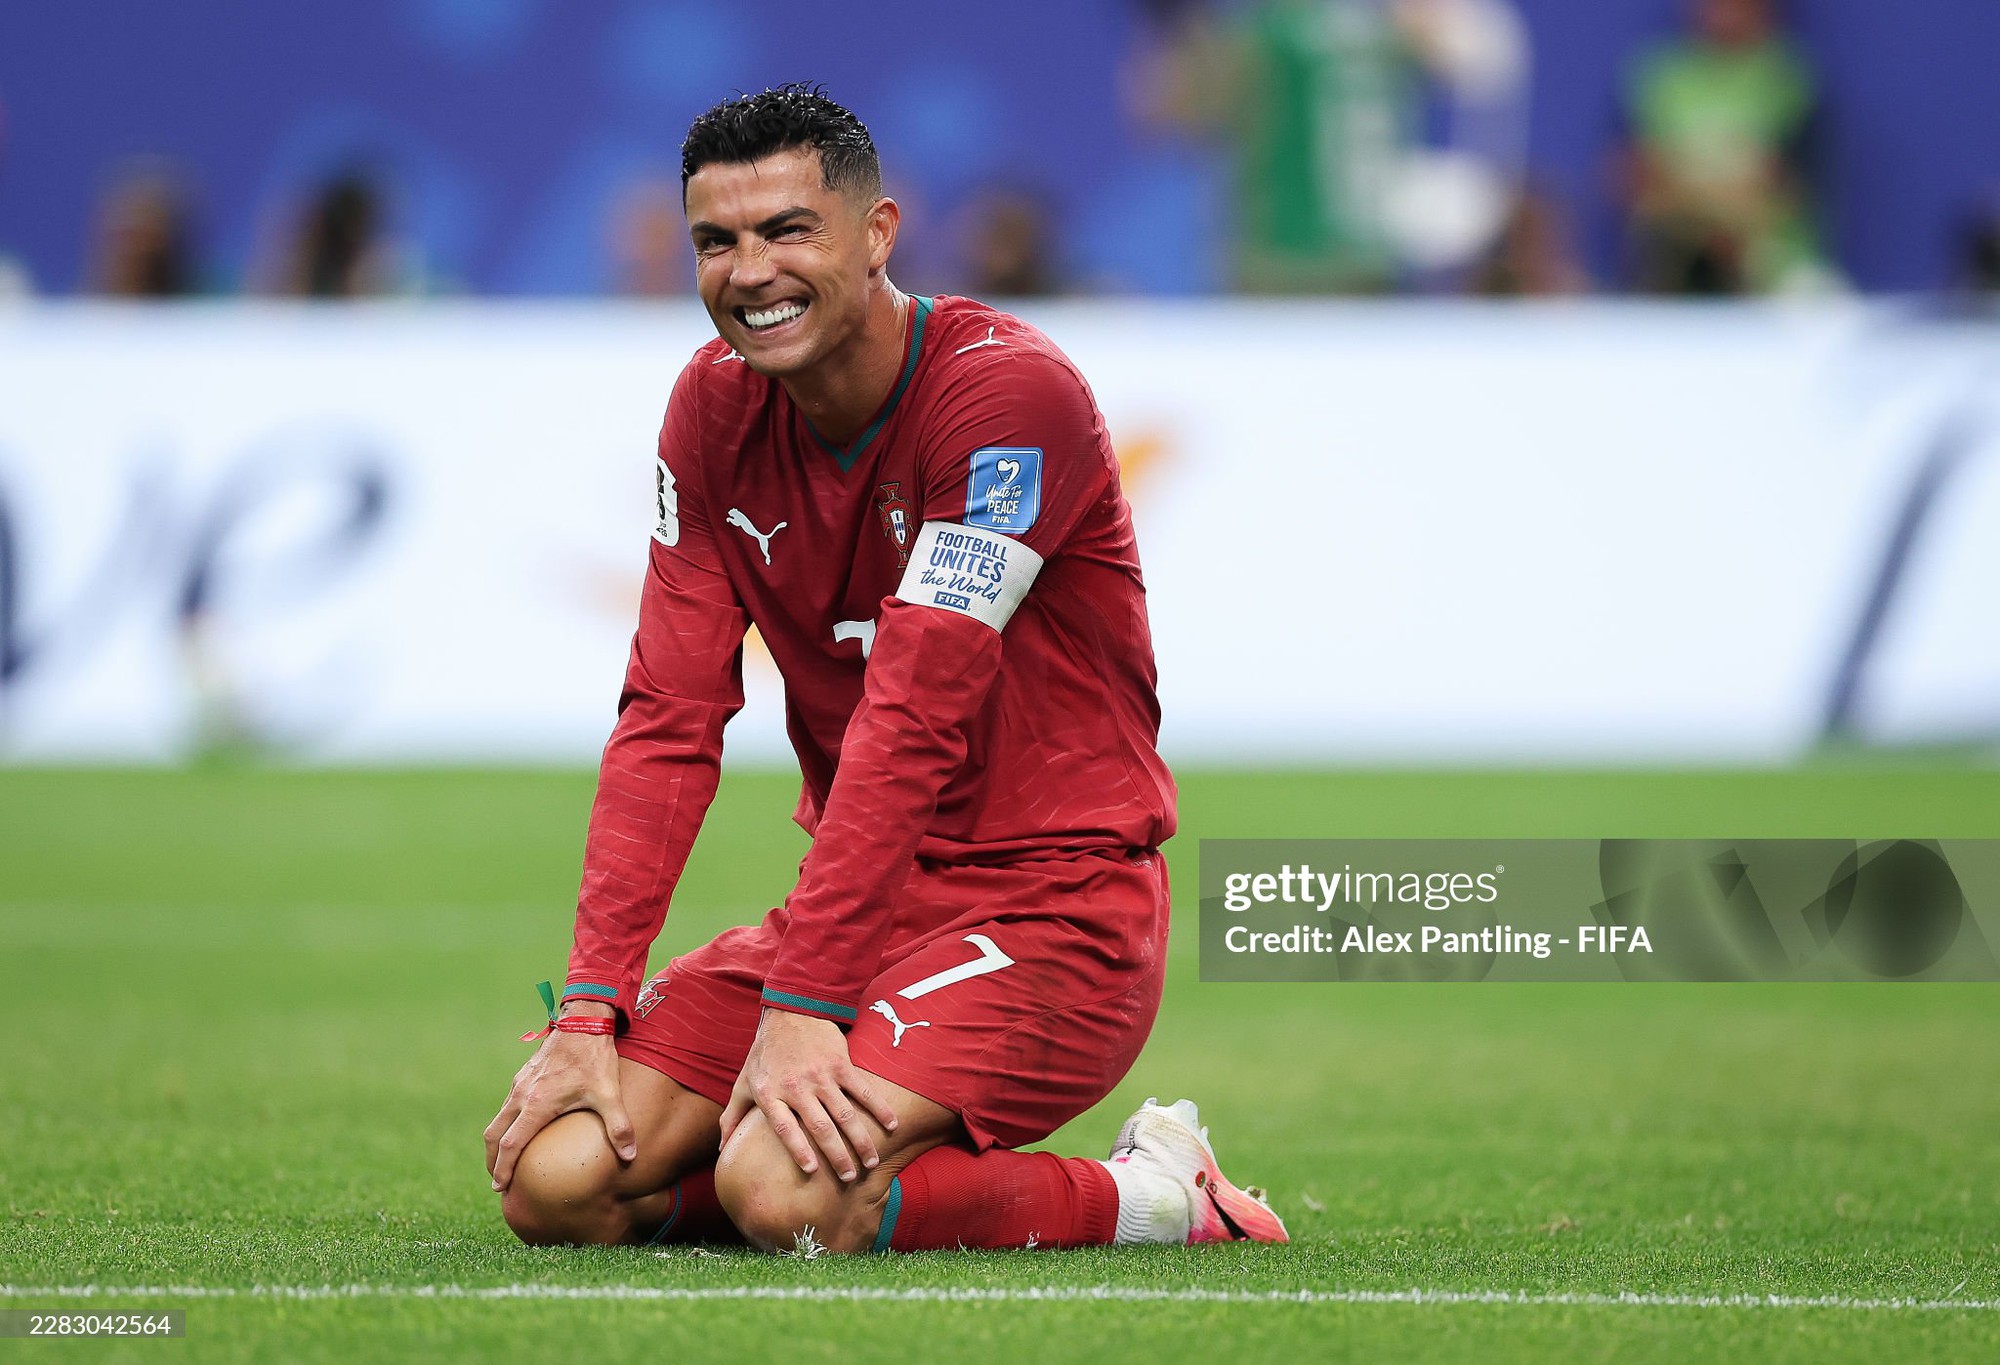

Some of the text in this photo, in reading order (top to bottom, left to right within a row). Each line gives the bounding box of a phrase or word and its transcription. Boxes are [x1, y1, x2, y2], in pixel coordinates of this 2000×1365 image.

[986, 484, 1022, 500] Unite For
[987, 500, 1019, 514] PEACE
[992, 515, 1010, 523] FIFA
[936, 531, 1007, 562] FOOTBALL
[930, 546, 1005, 582] UNITES
[920, 568, 1002, 604] the World
[937, 594, 967, 608] FIFA
[895, 934, 1016, 1000] 7
